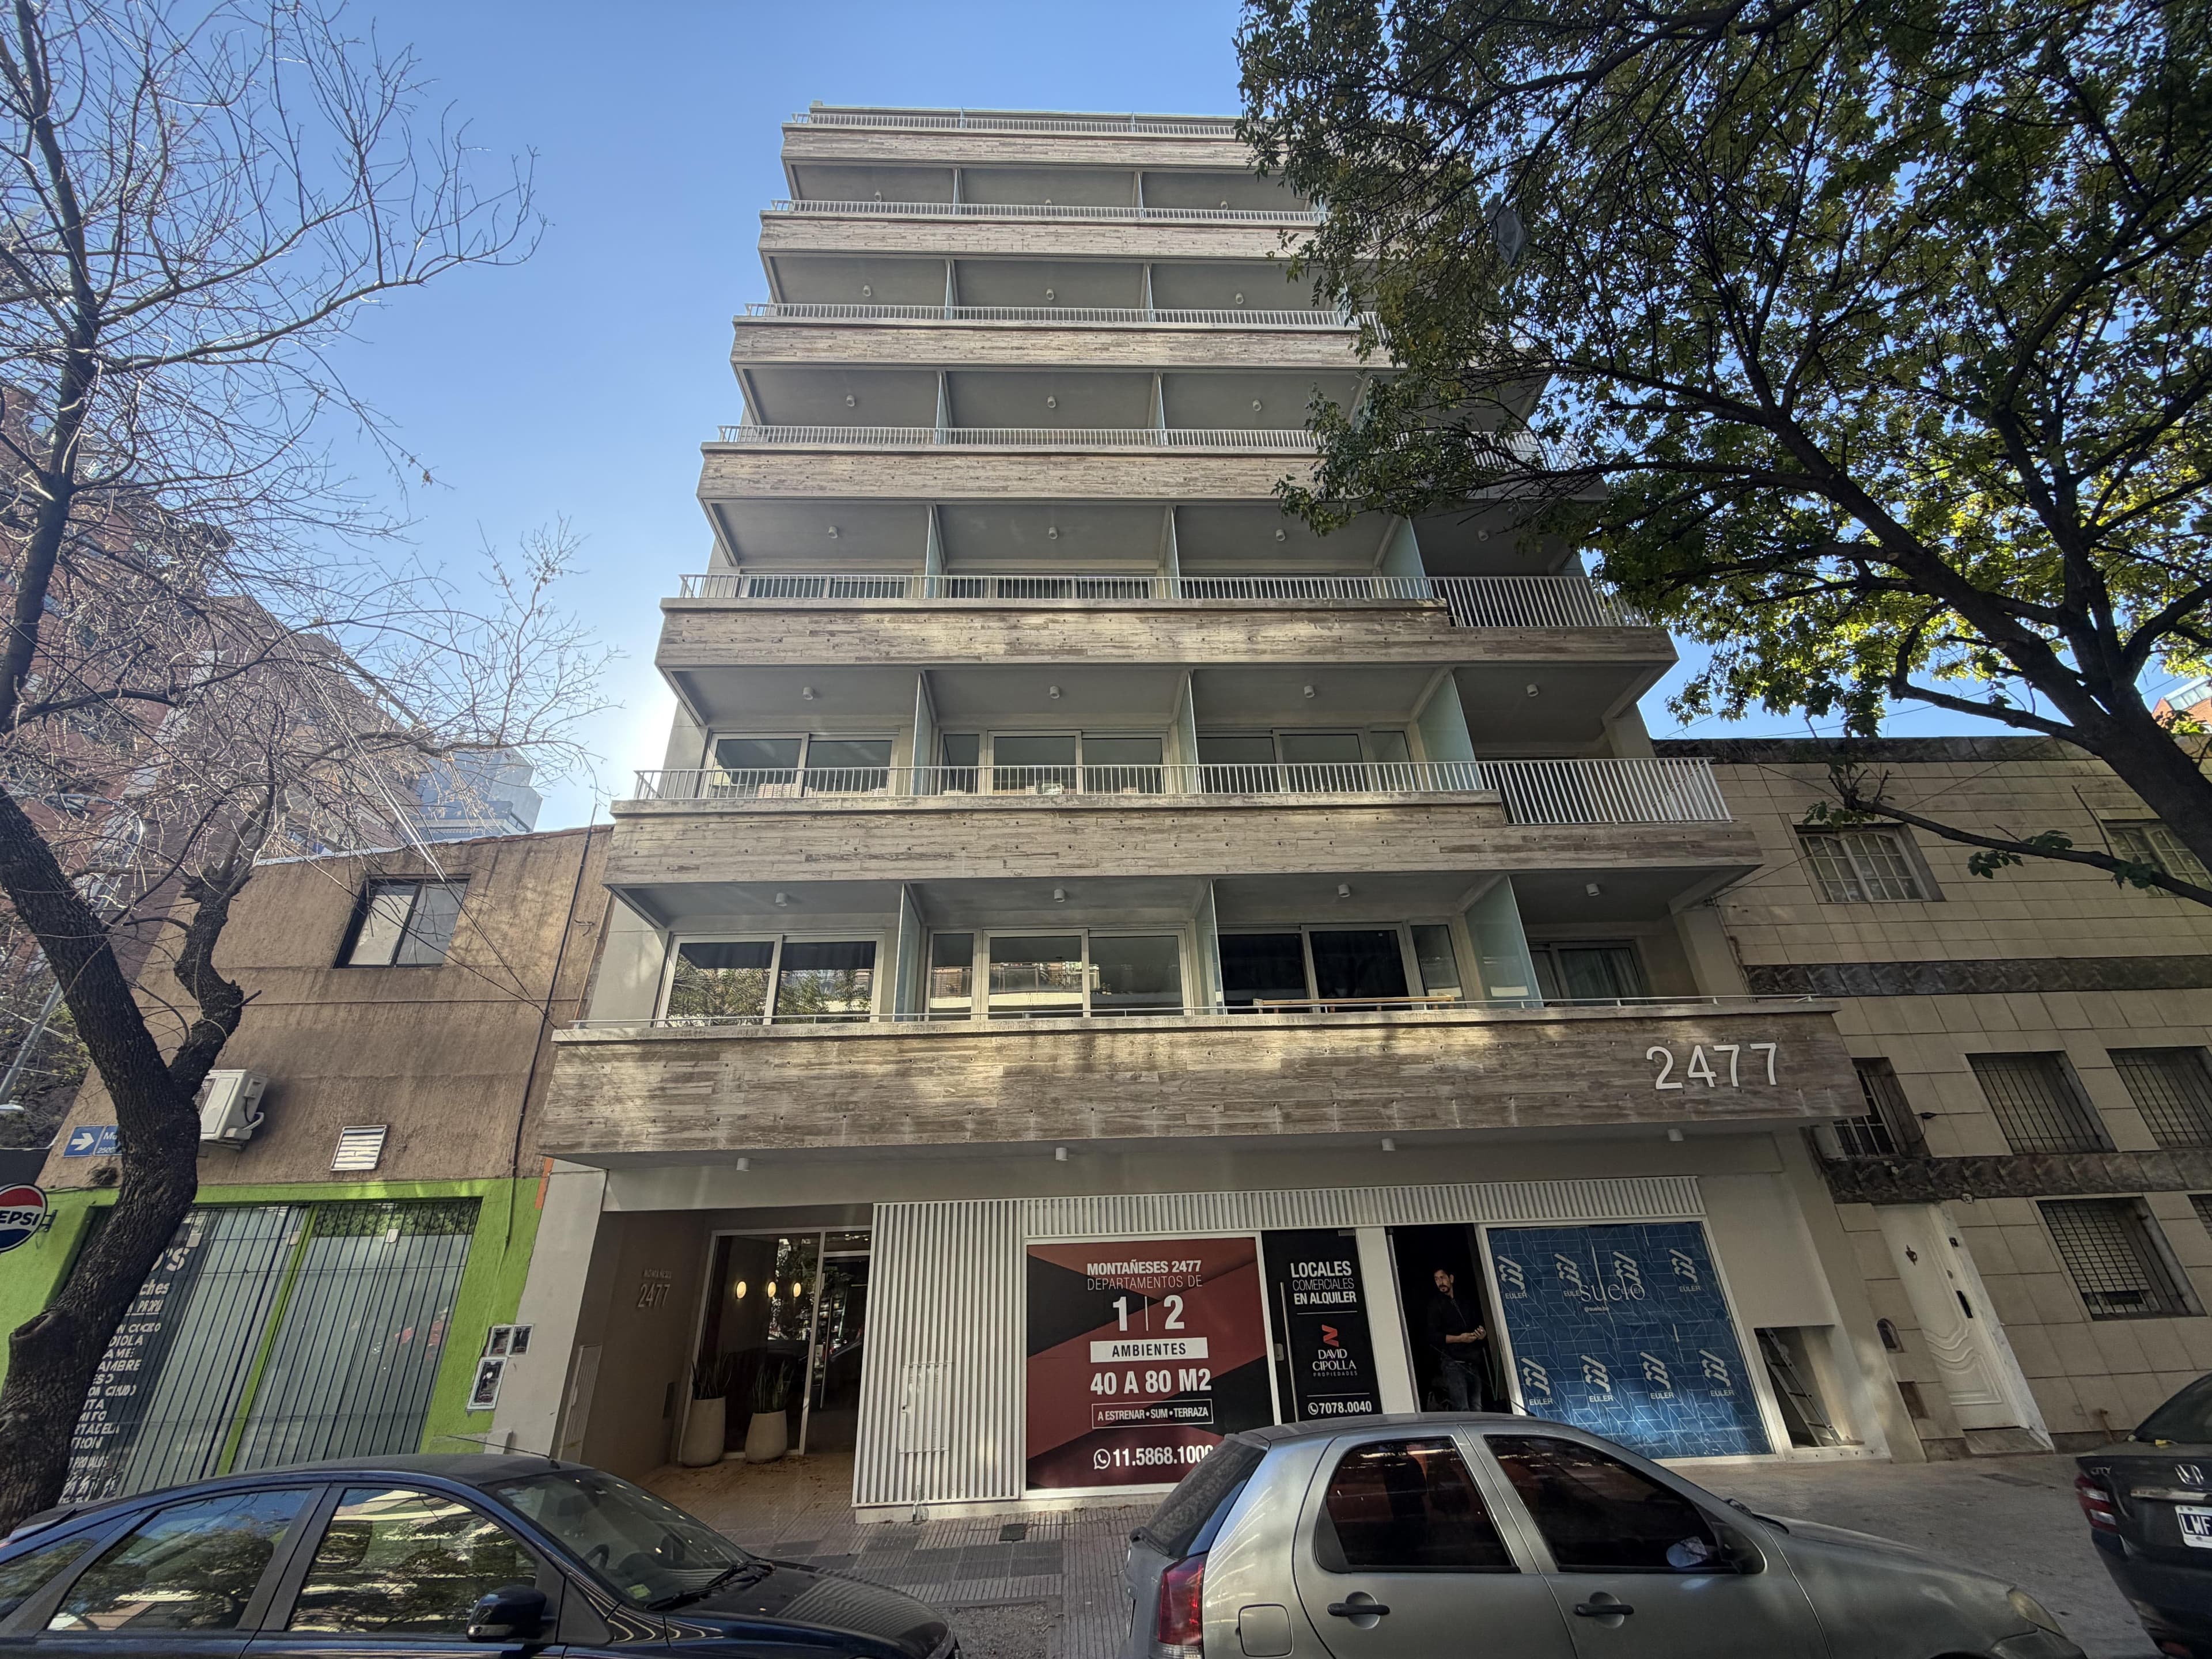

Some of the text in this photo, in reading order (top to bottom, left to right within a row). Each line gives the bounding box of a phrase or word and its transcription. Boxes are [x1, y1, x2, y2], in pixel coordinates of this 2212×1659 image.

[1646, 1043, 1777, 1090] 2477
[0, 1210, 41, 1226] EPSI
[1087, 1259, 1202, 1275] MONTAÑESES 2477
[1290, 1260, 1352, 1278] LOCALES
[1088, 1275, 1203, 1290] DEPARTAMENTOS DE
[1292, 1278, 1354, 1291] COMERCIALES
[1579, 1271, 1645, 1302] suelo
[638, 1283, 671, 1308] 2477
[1294, 1291, 1357, 1305] EN ALQUILER
[1112, 1295, 1184, 1331] 1 2
[109, 1335, 143, 1347] DIOLA
[1112, 1343, 1186, 1357] AMBIENTES
[1317, 1349, 1347, 1359] DAVID
[1312, 1359, 1357, 1371] CIPOLLA
[1090, 1368, 1211, 1395] 40 A 80 M2
[1589, 1394, 1613, 1403] EULER
[1650, 1391, 1675, 1400] EULER
[1097, 1407, 1209, 1421] A ESTRENAR SUM TERRAZA
[1319, 1400, 1372, 1414] 7078.0040
[2180, 1514, 2212, 1535] LWF
